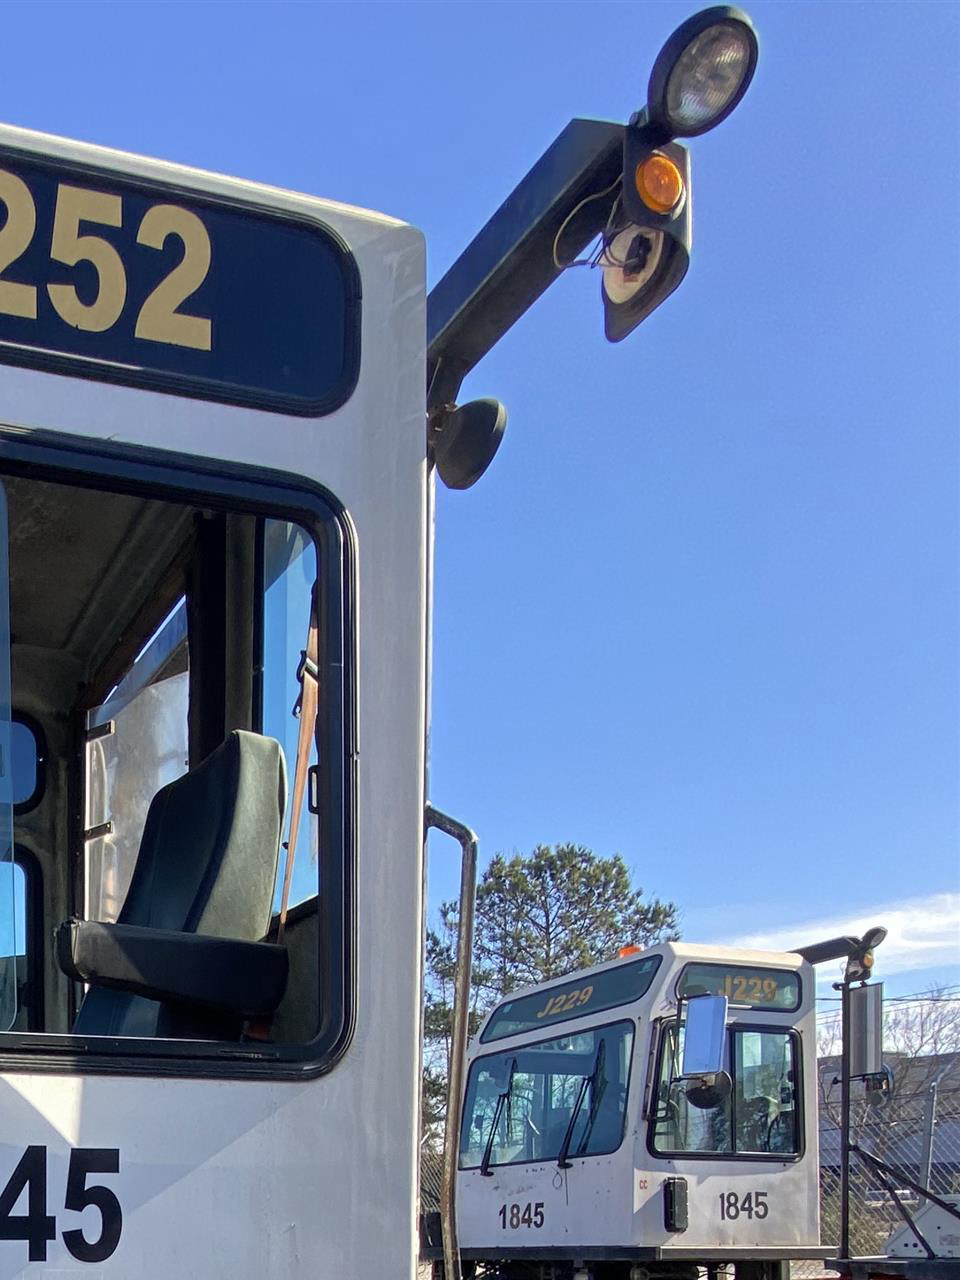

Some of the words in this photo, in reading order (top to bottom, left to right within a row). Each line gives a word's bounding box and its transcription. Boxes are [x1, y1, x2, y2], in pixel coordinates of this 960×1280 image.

[536, 985, 594, 1020] J229
[718, 973, 779, 1004] J229
[498, 1202, 545, 1230] 1845
[719, 1191, 770, 1221] 1845
